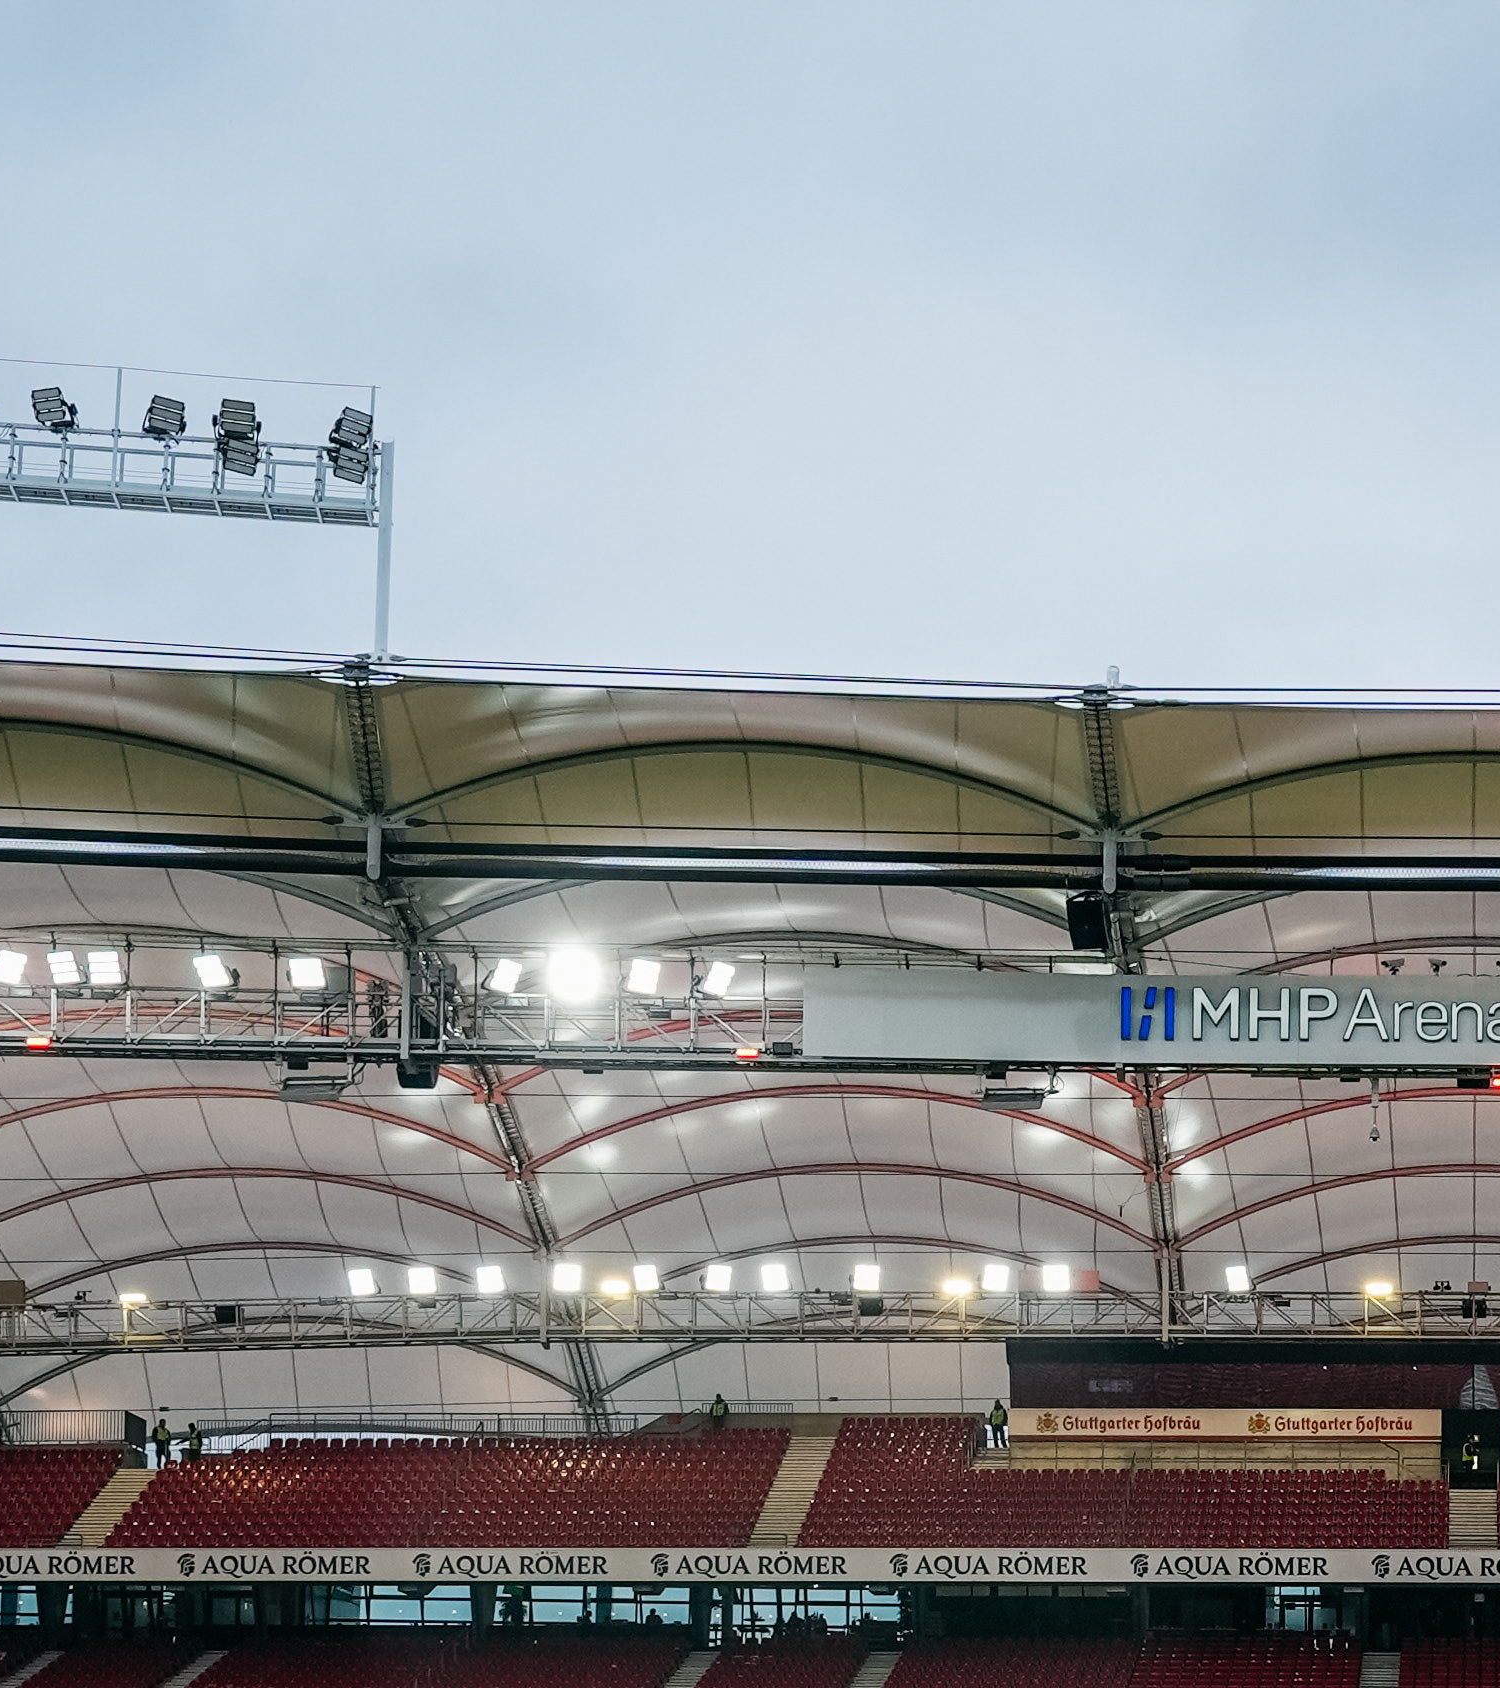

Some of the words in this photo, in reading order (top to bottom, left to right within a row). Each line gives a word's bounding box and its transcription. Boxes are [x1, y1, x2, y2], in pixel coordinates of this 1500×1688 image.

[1063, 1415, 1140, 1433] Stuttgarter
[1144, 1414, 1201, 1434] Hofbräu
[1275, 1415, 1352, 1434] Stuttgarter
[1356, 1415, 1413, 1434] Hofbräu
[47, 1551, 135, 1574] RÖMER
[201, 1554, 275, 1578] AQUA
[282, 1551, 370, 1574] RÖMER
[437, 1554, 512, 1578] AQUA
[519, 1551, 607, 1574] RÖMER
[675, 1554, 750, 1578] AQUA
[758, 1551, 847, 1574] RÖMER
[914, 1554, 990, 1578] AQUA
[998, 1551, 1087, 1575] RÖMER
[1155, 1555, 1231, 1578] AQUA
[1238, 1552, 1328, 1575] RÖMER
[1396, 1556, 1472, 1579] AQUA
